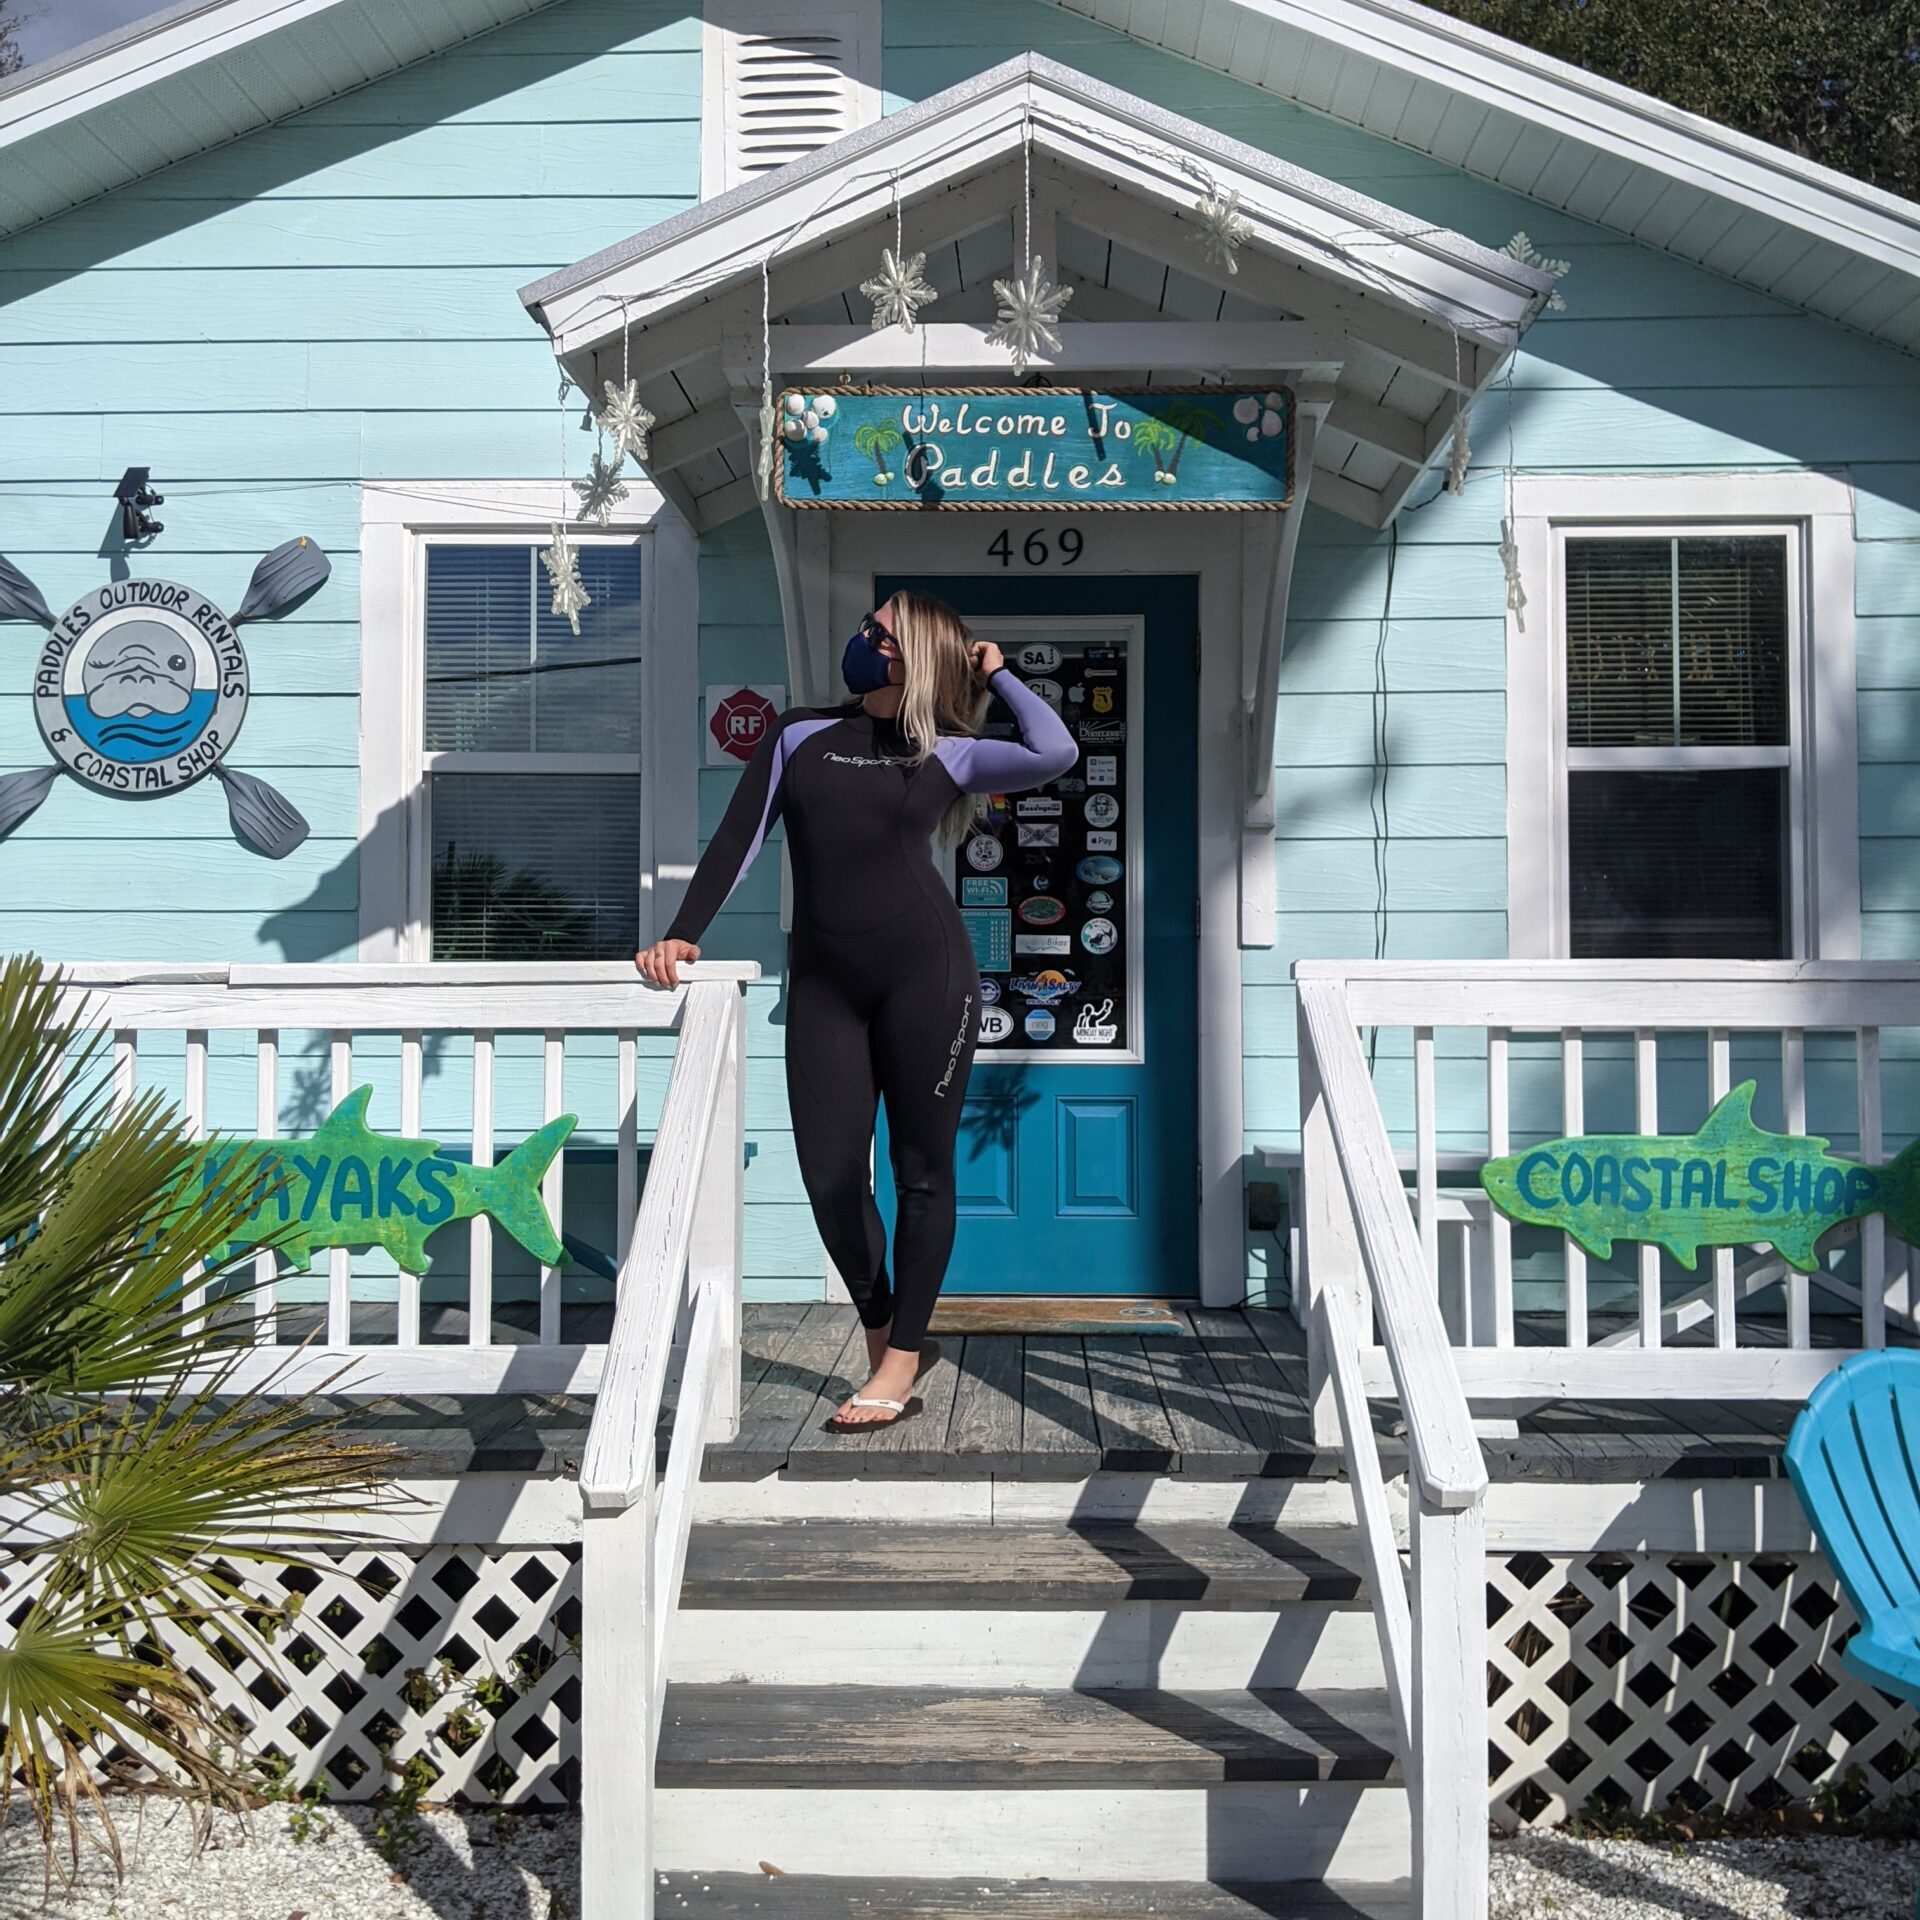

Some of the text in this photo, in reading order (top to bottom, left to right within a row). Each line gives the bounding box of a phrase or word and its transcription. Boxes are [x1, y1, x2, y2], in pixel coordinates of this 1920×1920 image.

[902, 402, 1132, 440] Welcome To
[905, 442, 1127, 491] Paddles
[987, 527, 1084, 568] 469
[37, 582, 244, 699] PADDLES OUTDOOR RENTALS
[730, 715, 762, 735] RF
[51, 728, 223, 789] & COASTAL SHOP
[1098, 837, 1113, 846] Pay
[1047, 937, 1068, 946] Bikes
[1031, 1019, 1049, 1030] ring
[1098, 1028, 1113, 1037] NIGHT
[202, 1154, 457, 1225] KAYAKS
[1516, 1151, 1878, 1215] COASTAL SHOP
